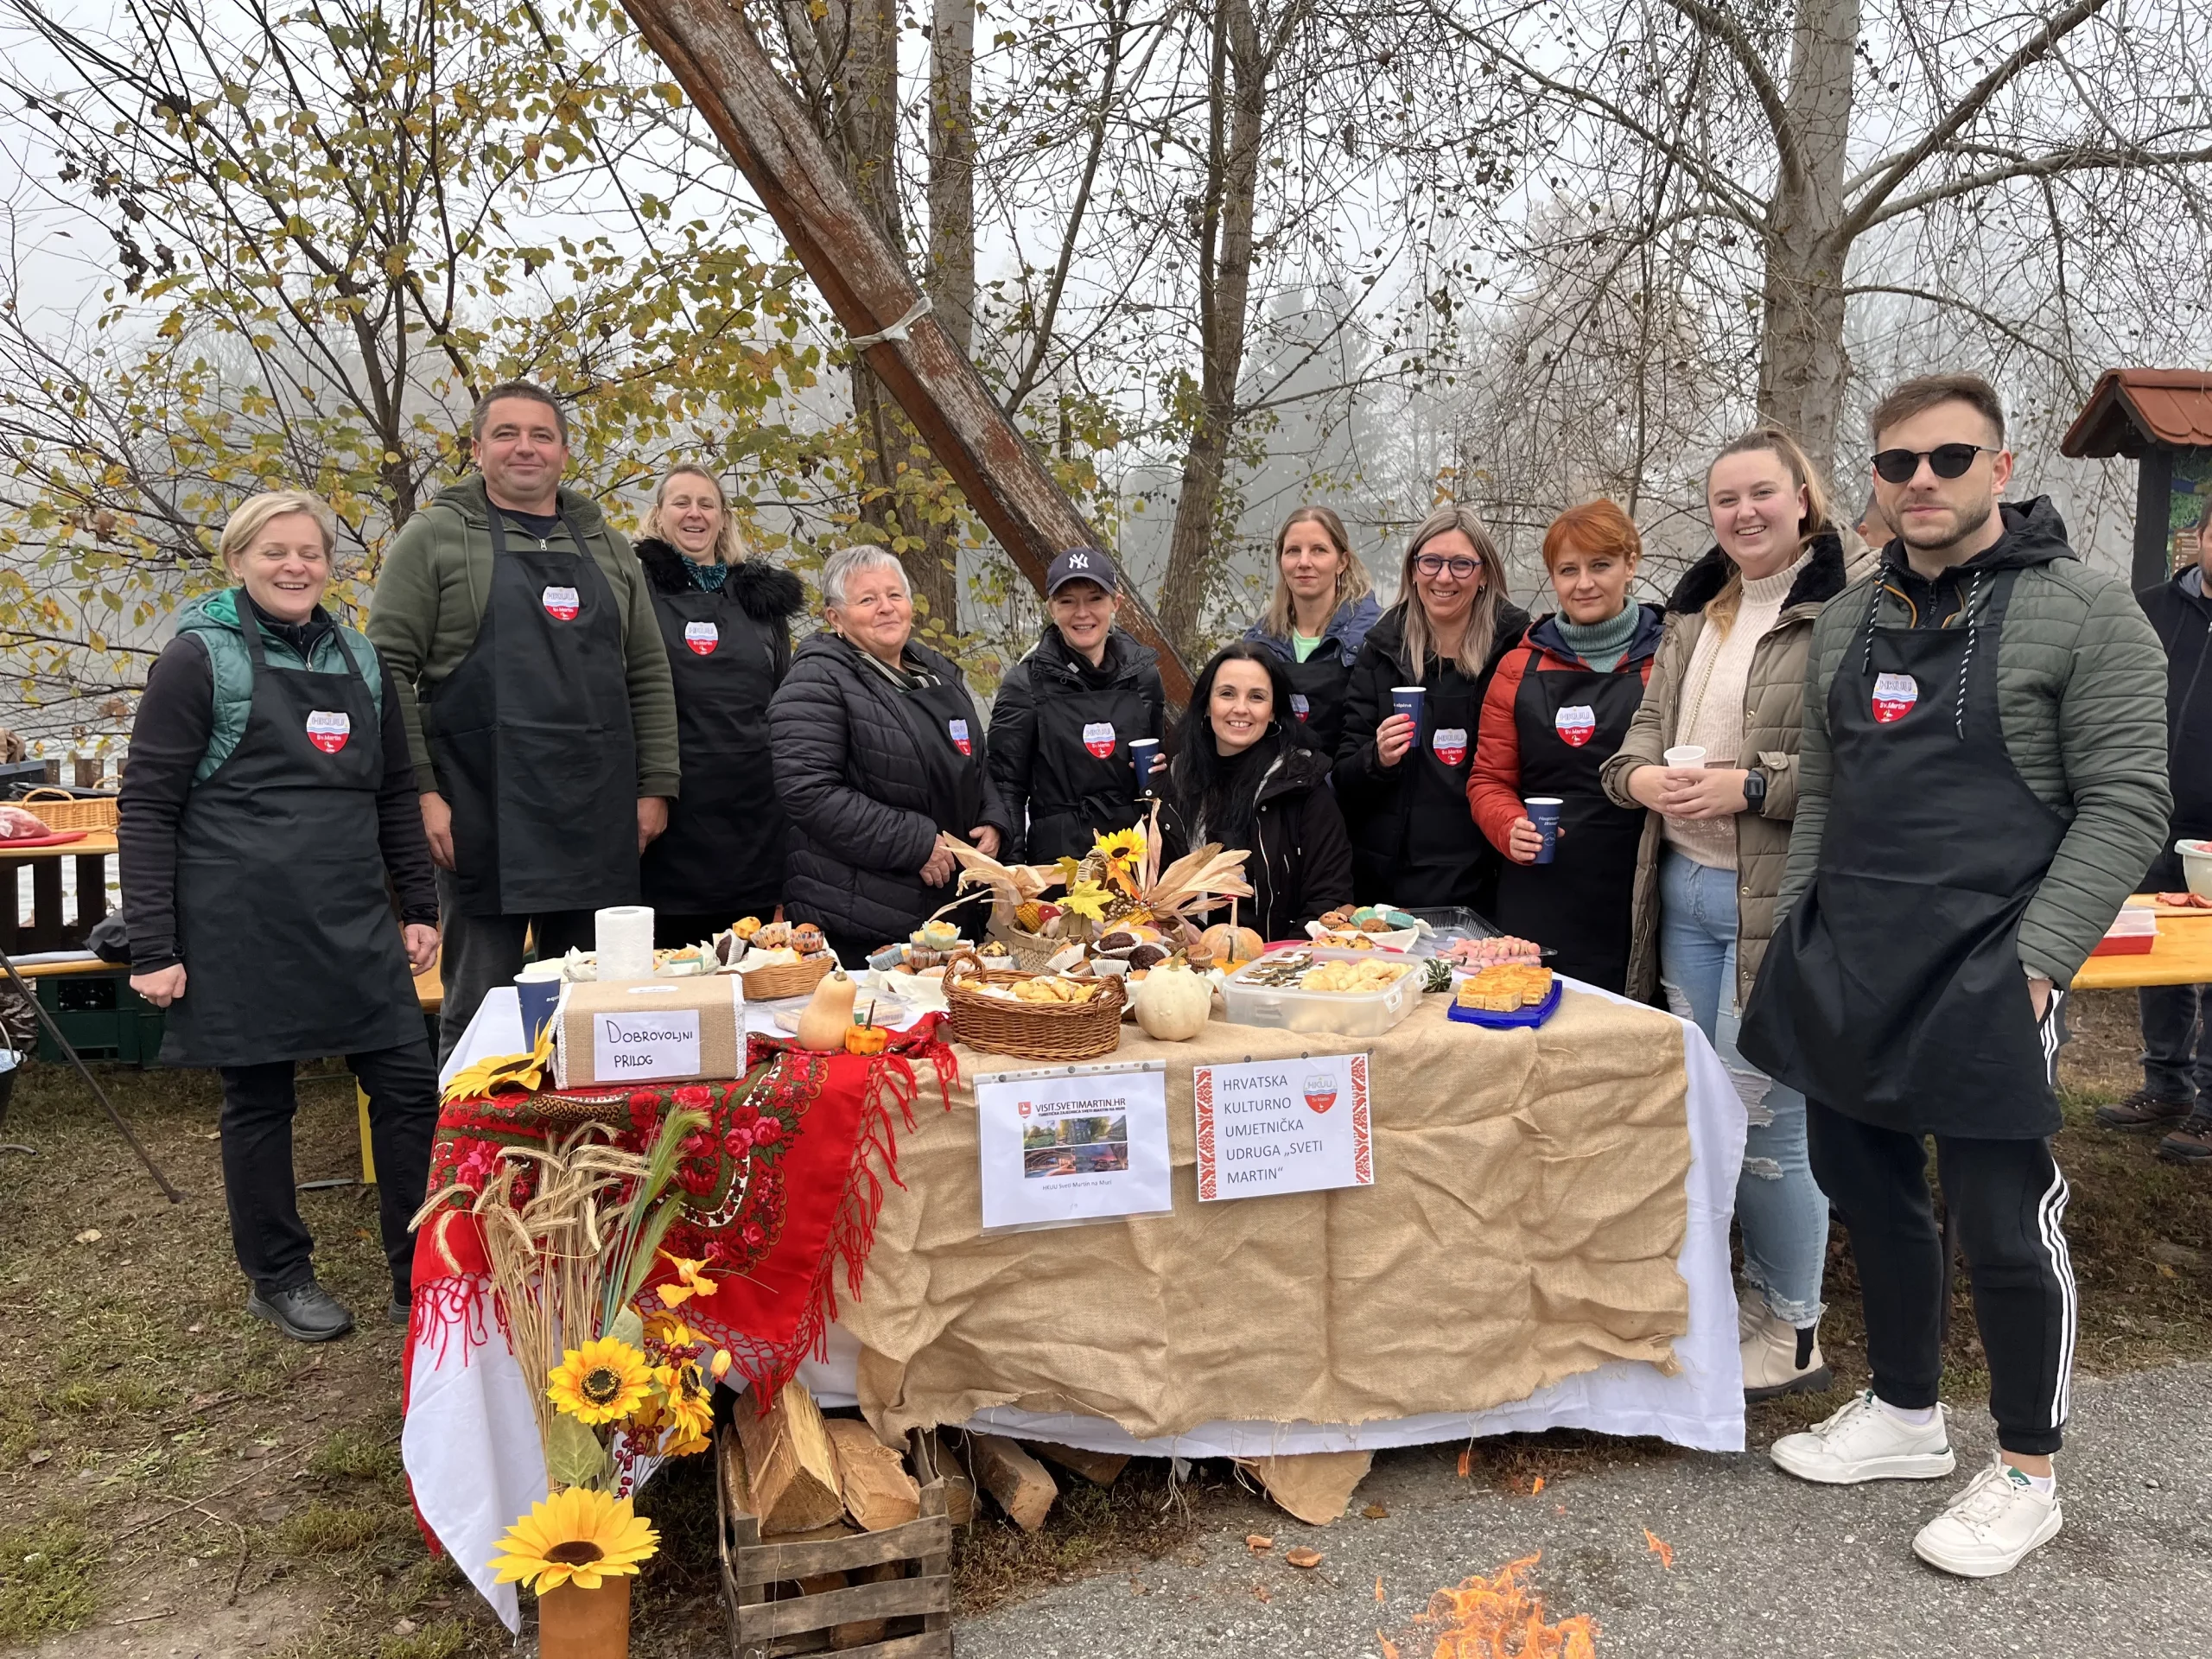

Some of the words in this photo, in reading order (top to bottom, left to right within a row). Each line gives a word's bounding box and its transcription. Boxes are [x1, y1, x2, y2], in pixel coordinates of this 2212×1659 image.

[1069, 553, 1089, 569] NY
[1879, 680, 1912, 692] HKUU
[613, 1055, 653, 1068] PRILOG
[1223, 1075, 1288, 1091] HRVATSKA
[1307, 1080, 1332, 1089] HKUU
[1035, 1097, 1126, 1113] VISIT.SVETIMARTIN.HR
[1224, 1096, 1292, 1115] KULTURNO
[1225, 1117, 1304, 1137] UMJETNIČKA
[1226, 1144, 1281, 1160] UDRUGA
